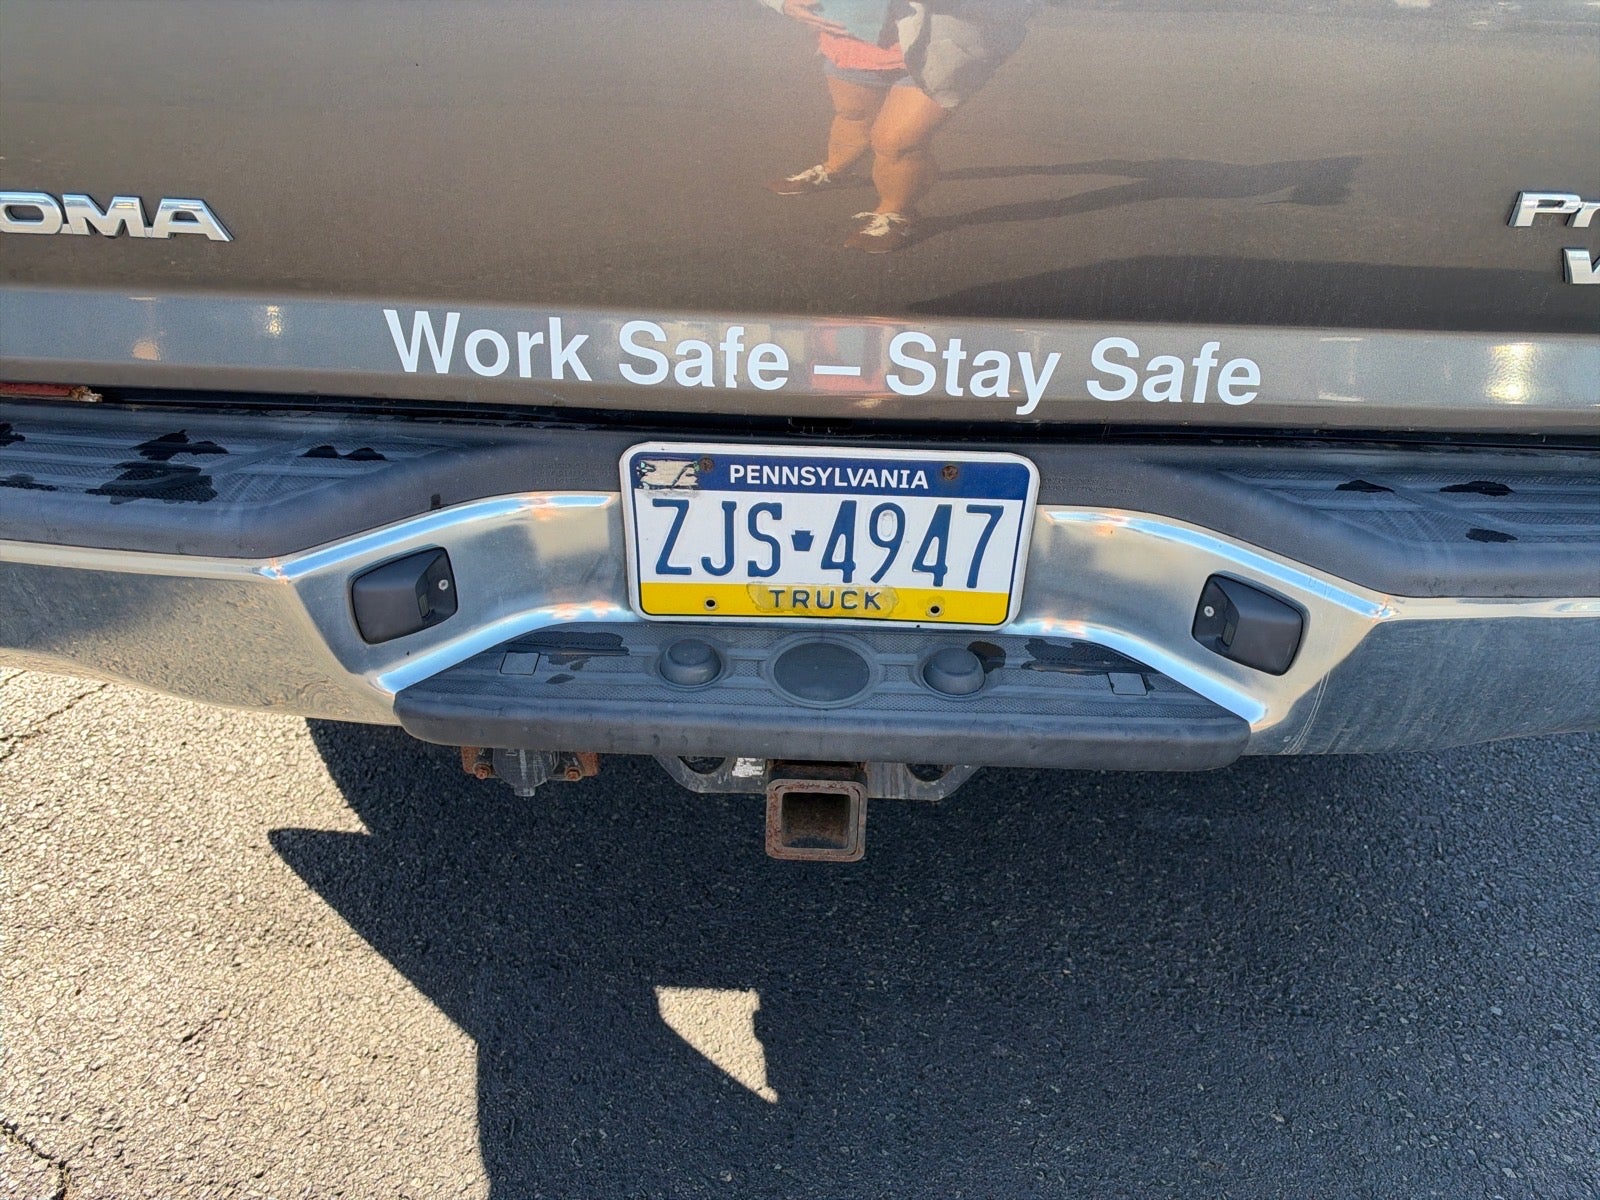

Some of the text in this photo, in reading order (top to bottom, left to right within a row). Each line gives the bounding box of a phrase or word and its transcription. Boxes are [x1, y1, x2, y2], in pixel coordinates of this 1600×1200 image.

[383, 308, 592, 382] Work
[618, 319, 789, 391] Safe
[885, 331, 1062, 416] Stay
[1085, 336, 1261, 406] Safe
[729, 463, 929, 490] PENNSYLVANIA
[769, 589, 881, 610] TRUCK
